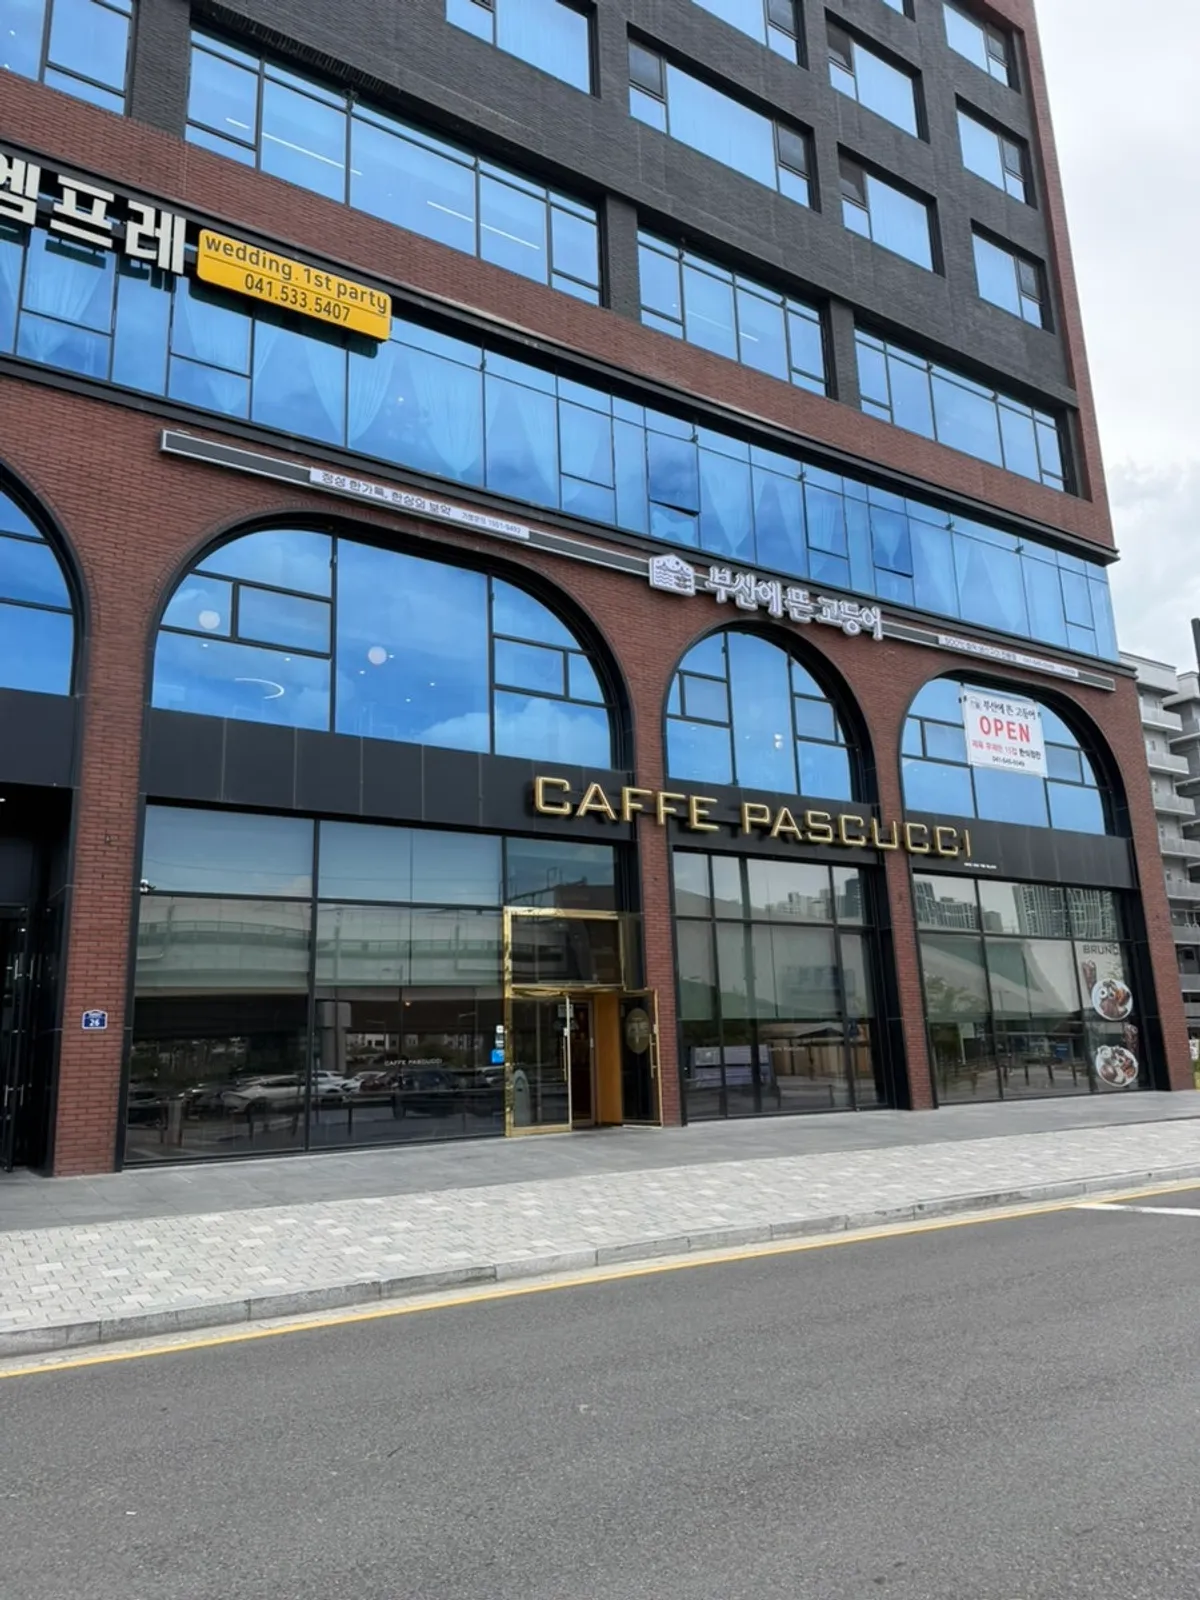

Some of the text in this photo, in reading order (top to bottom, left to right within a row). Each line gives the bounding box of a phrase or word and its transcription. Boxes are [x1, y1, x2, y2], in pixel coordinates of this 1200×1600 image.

[244, 273, 350, 322] 041.533.5407
[337, 282, 388, 314] party
[704, 565, 884, 642] 부산에 뜬 고등어
[983, 700, 1005, 715] 부산에
[980, 715, 1031, 744] OPEN
[534, 776, 972, 858] CAFFE PASCUCCI
